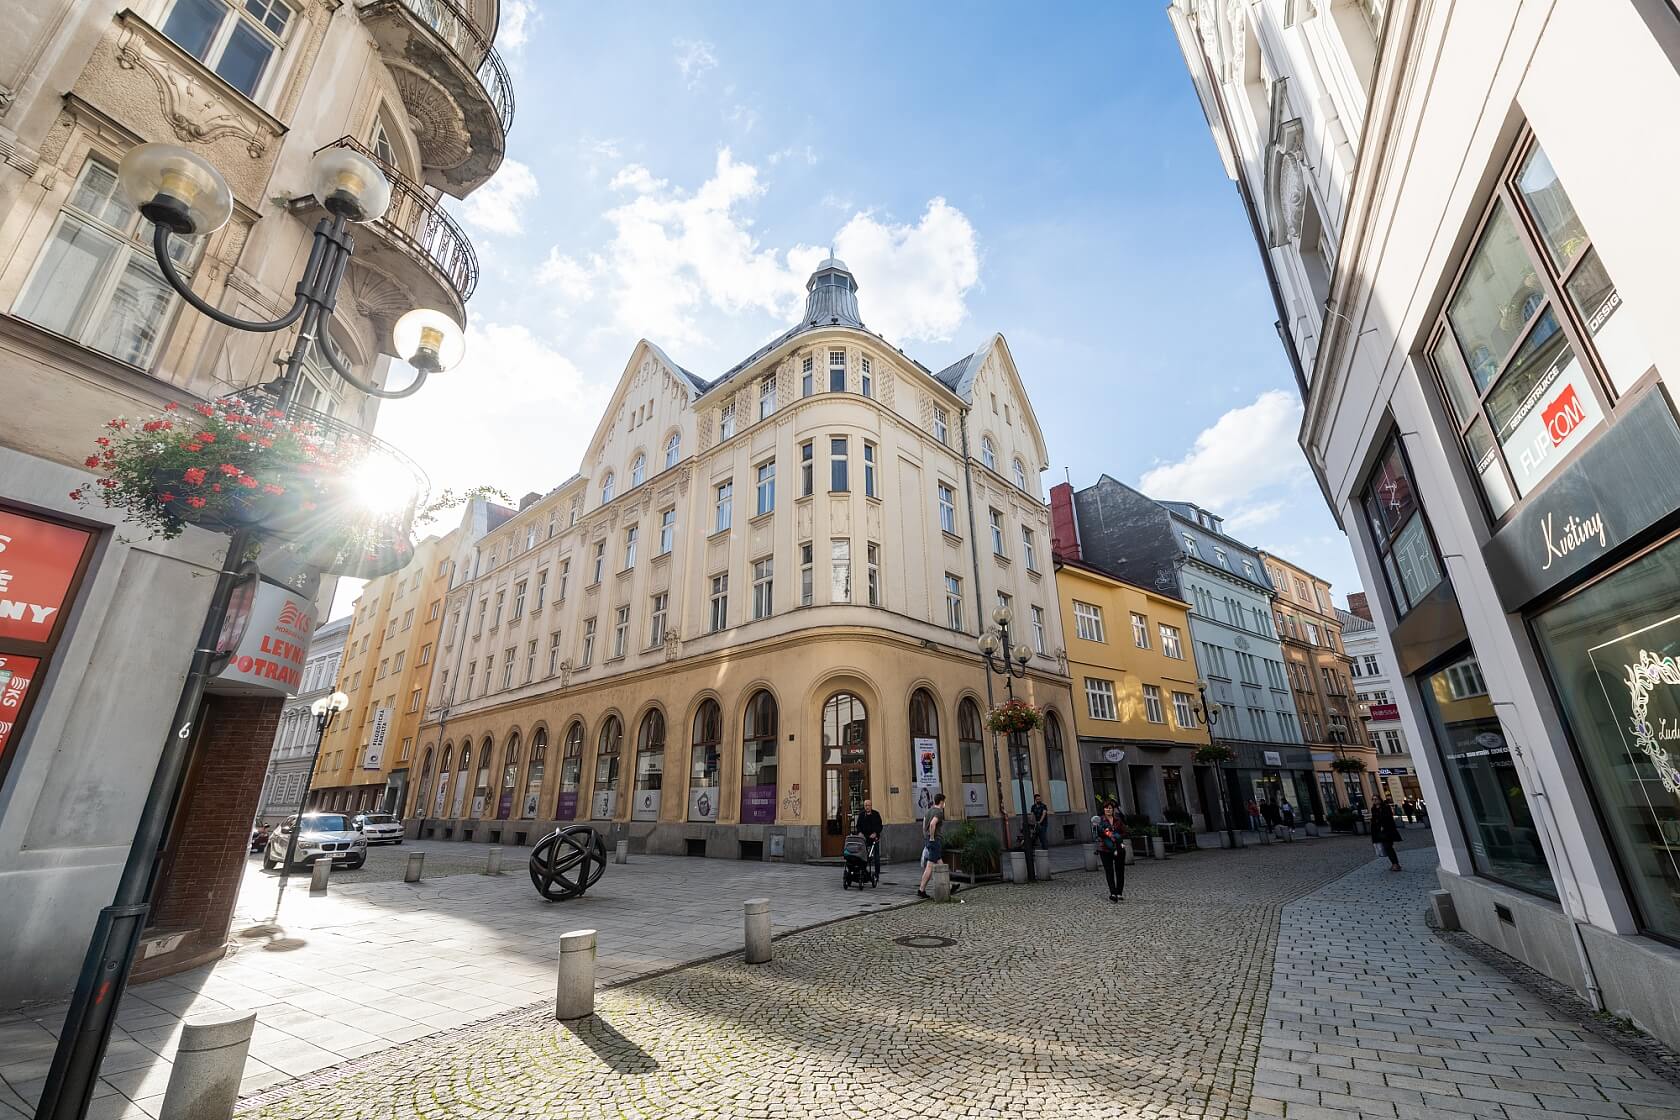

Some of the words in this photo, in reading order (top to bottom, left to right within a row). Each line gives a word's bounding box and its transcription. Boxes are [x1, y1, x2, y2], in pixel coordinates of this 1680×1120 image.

[1510, 365, 1560, 430] REKONSTRUKCE
[1541, 512, 1606, 570] Květiny
[377, 722, 387, 746] FAKULTA
